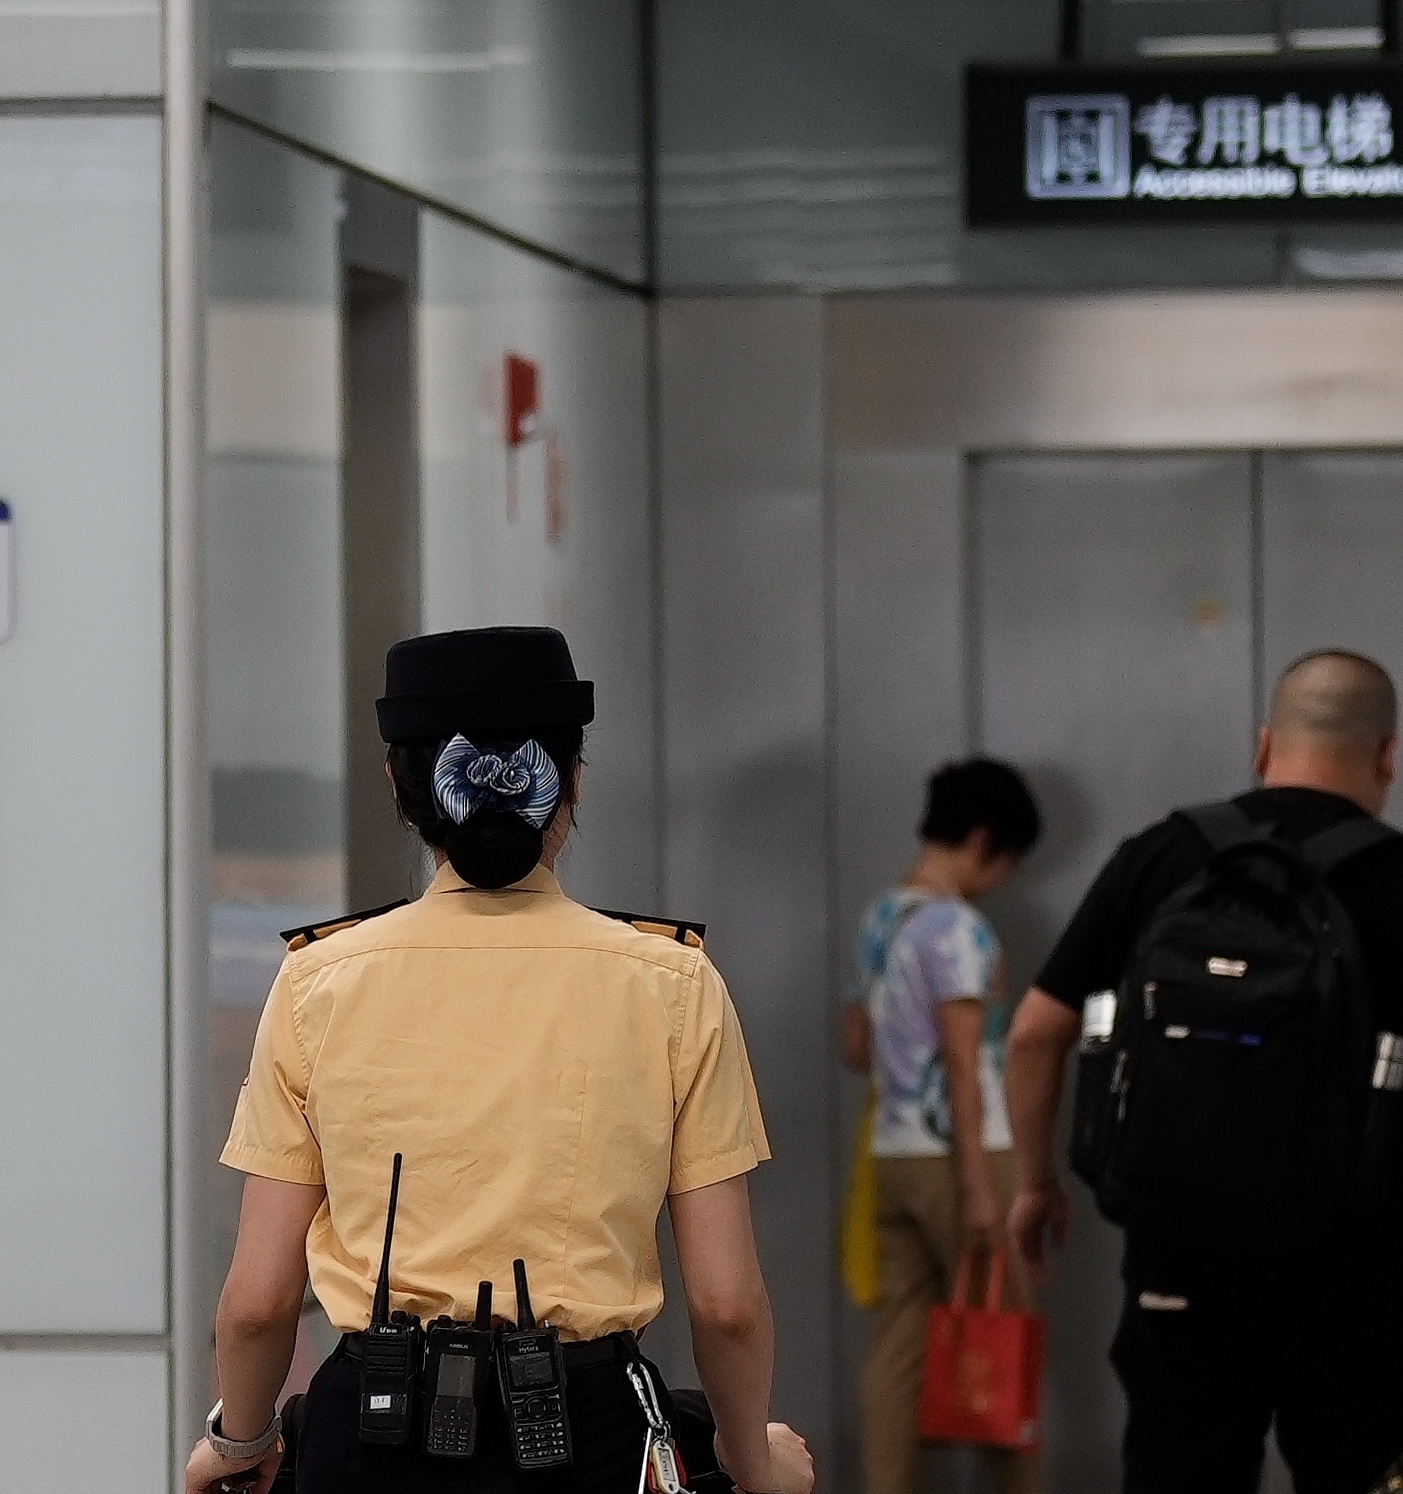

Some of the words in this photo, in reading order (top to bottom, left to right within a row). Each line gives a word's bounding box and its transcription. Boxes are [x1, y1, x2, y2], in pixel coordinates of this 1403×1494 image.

[1135, 93, 1393, 165] 专用电梯
[1134, 166, 1296, 198] Accessible
